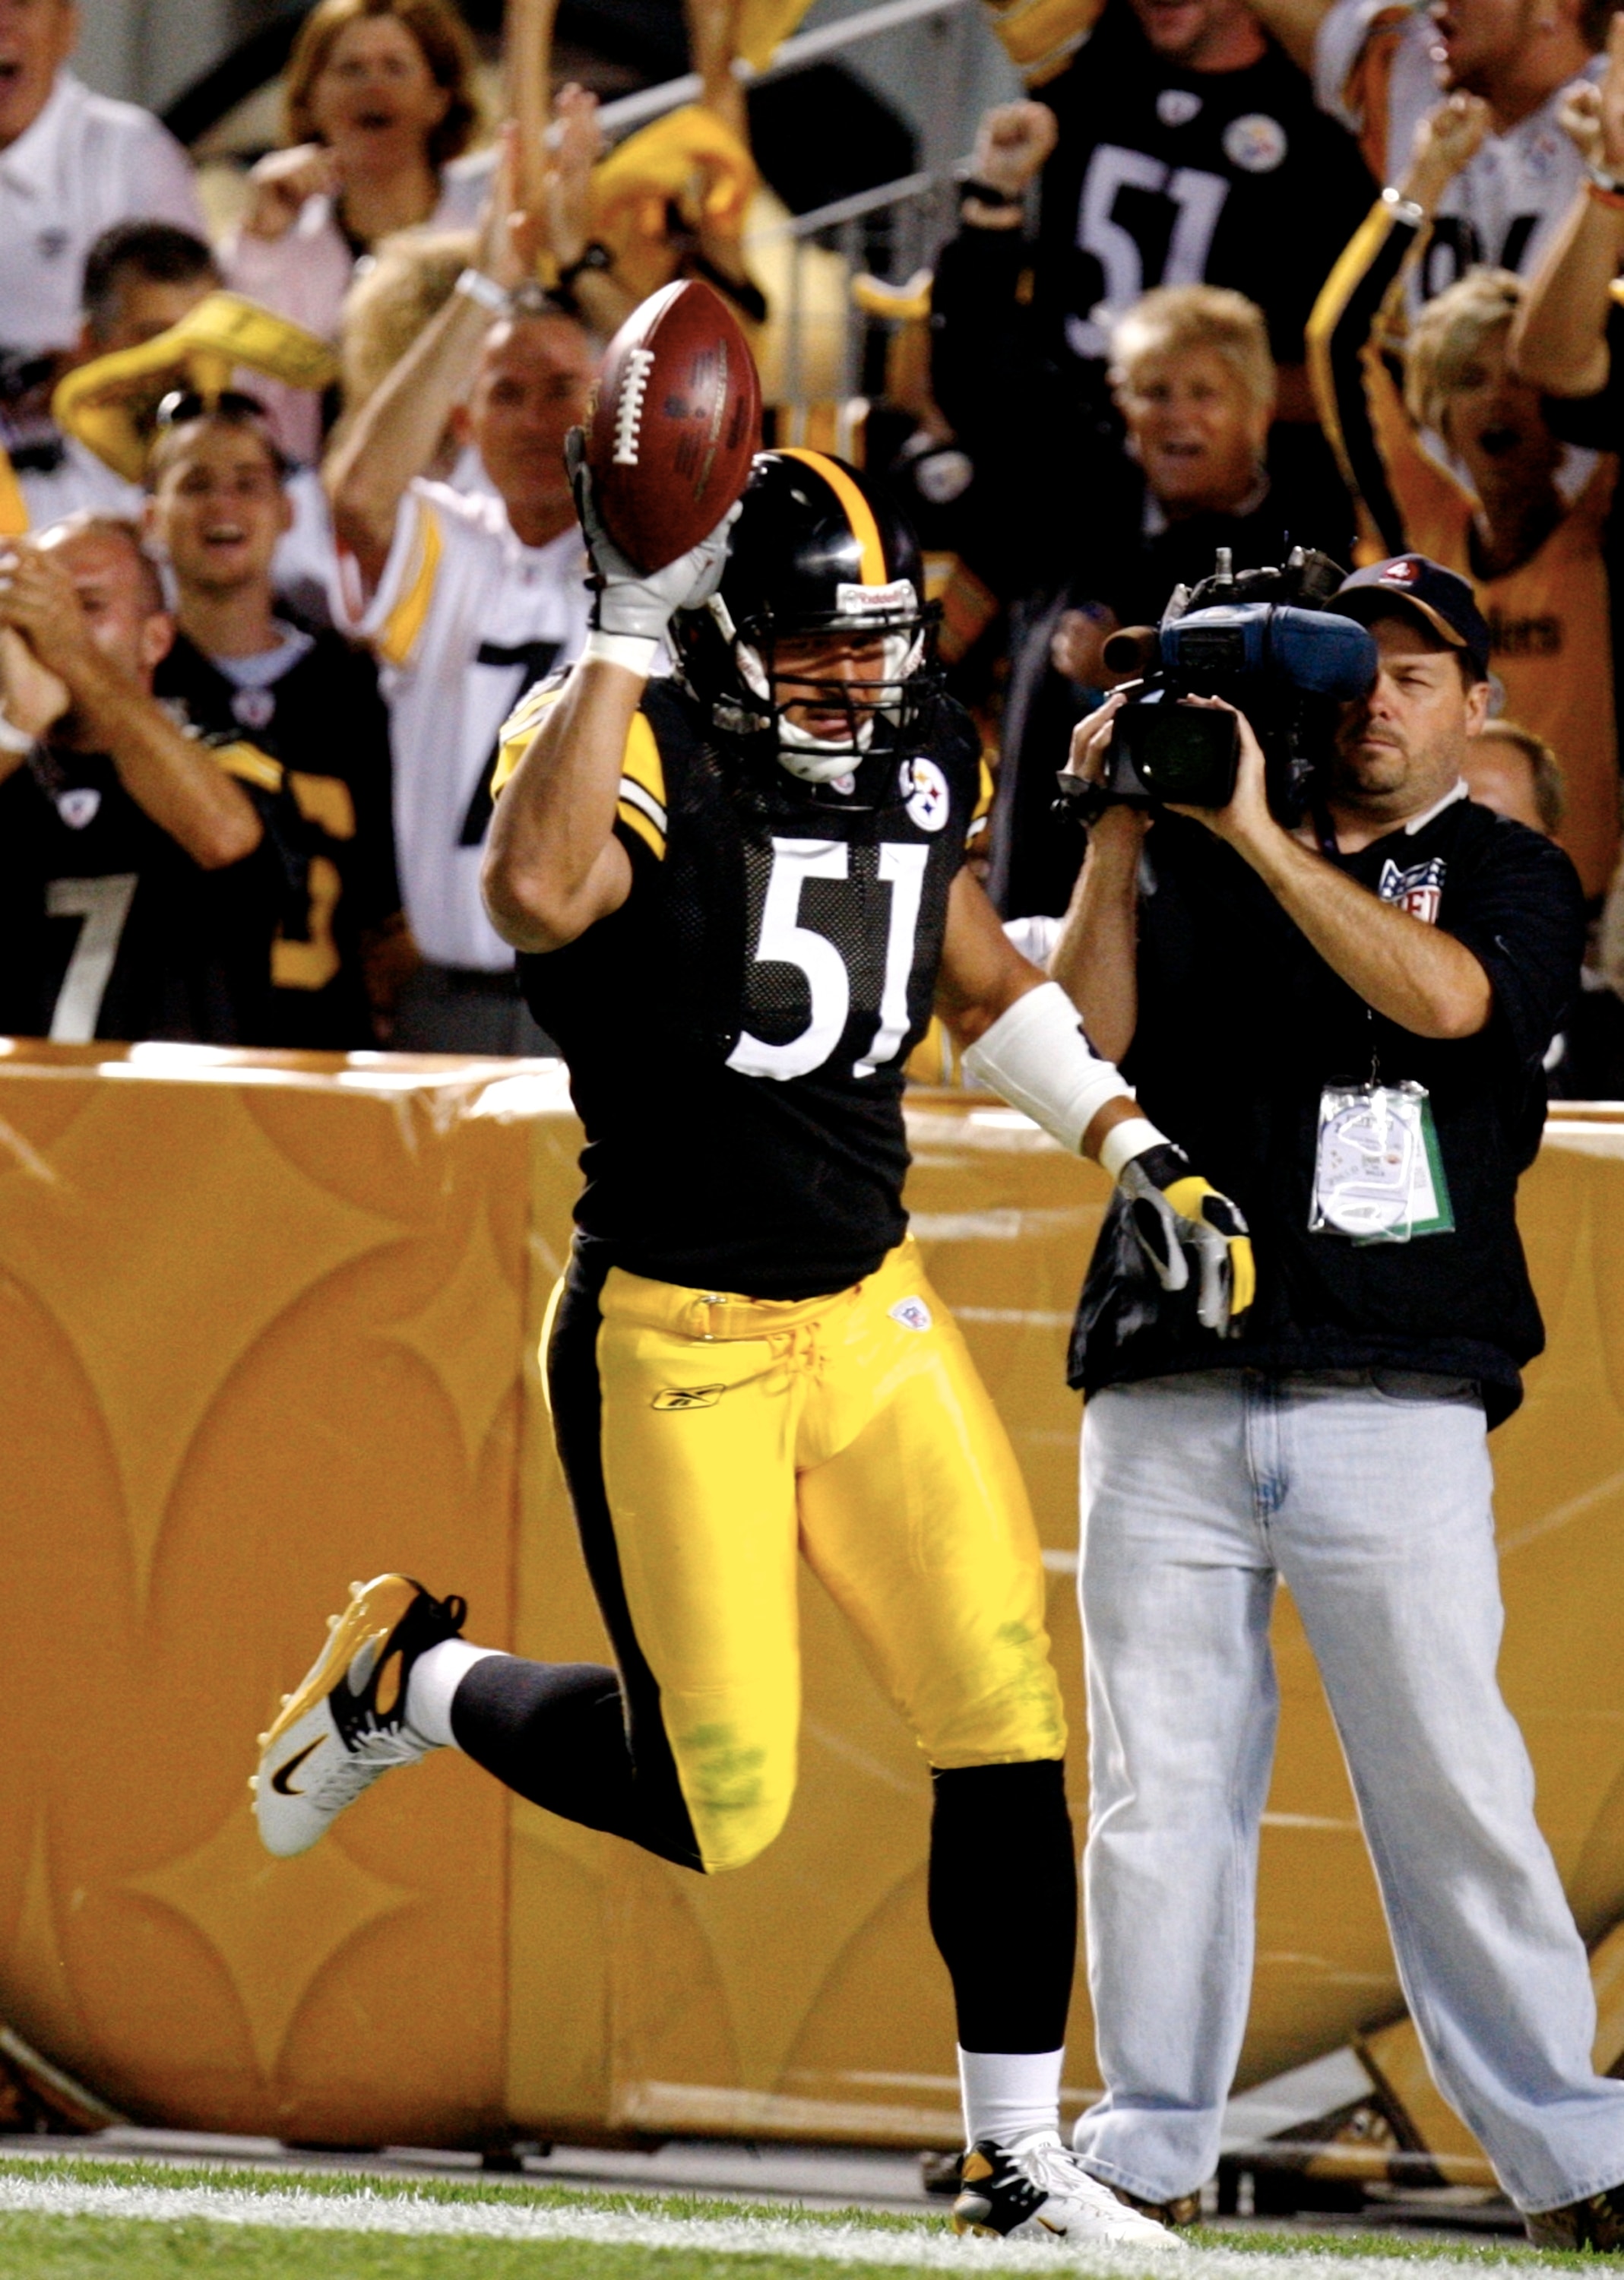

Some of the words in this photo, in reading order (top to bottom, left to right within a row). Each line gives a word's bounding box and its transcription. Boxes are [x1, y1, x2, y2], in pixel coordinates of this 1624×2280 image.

[1065, 143, 1230, 360] 51
[458, 640, 564, 846] 7
[46, 872, 139, 1046] 7
[725, 836, 929, 1081] 51
